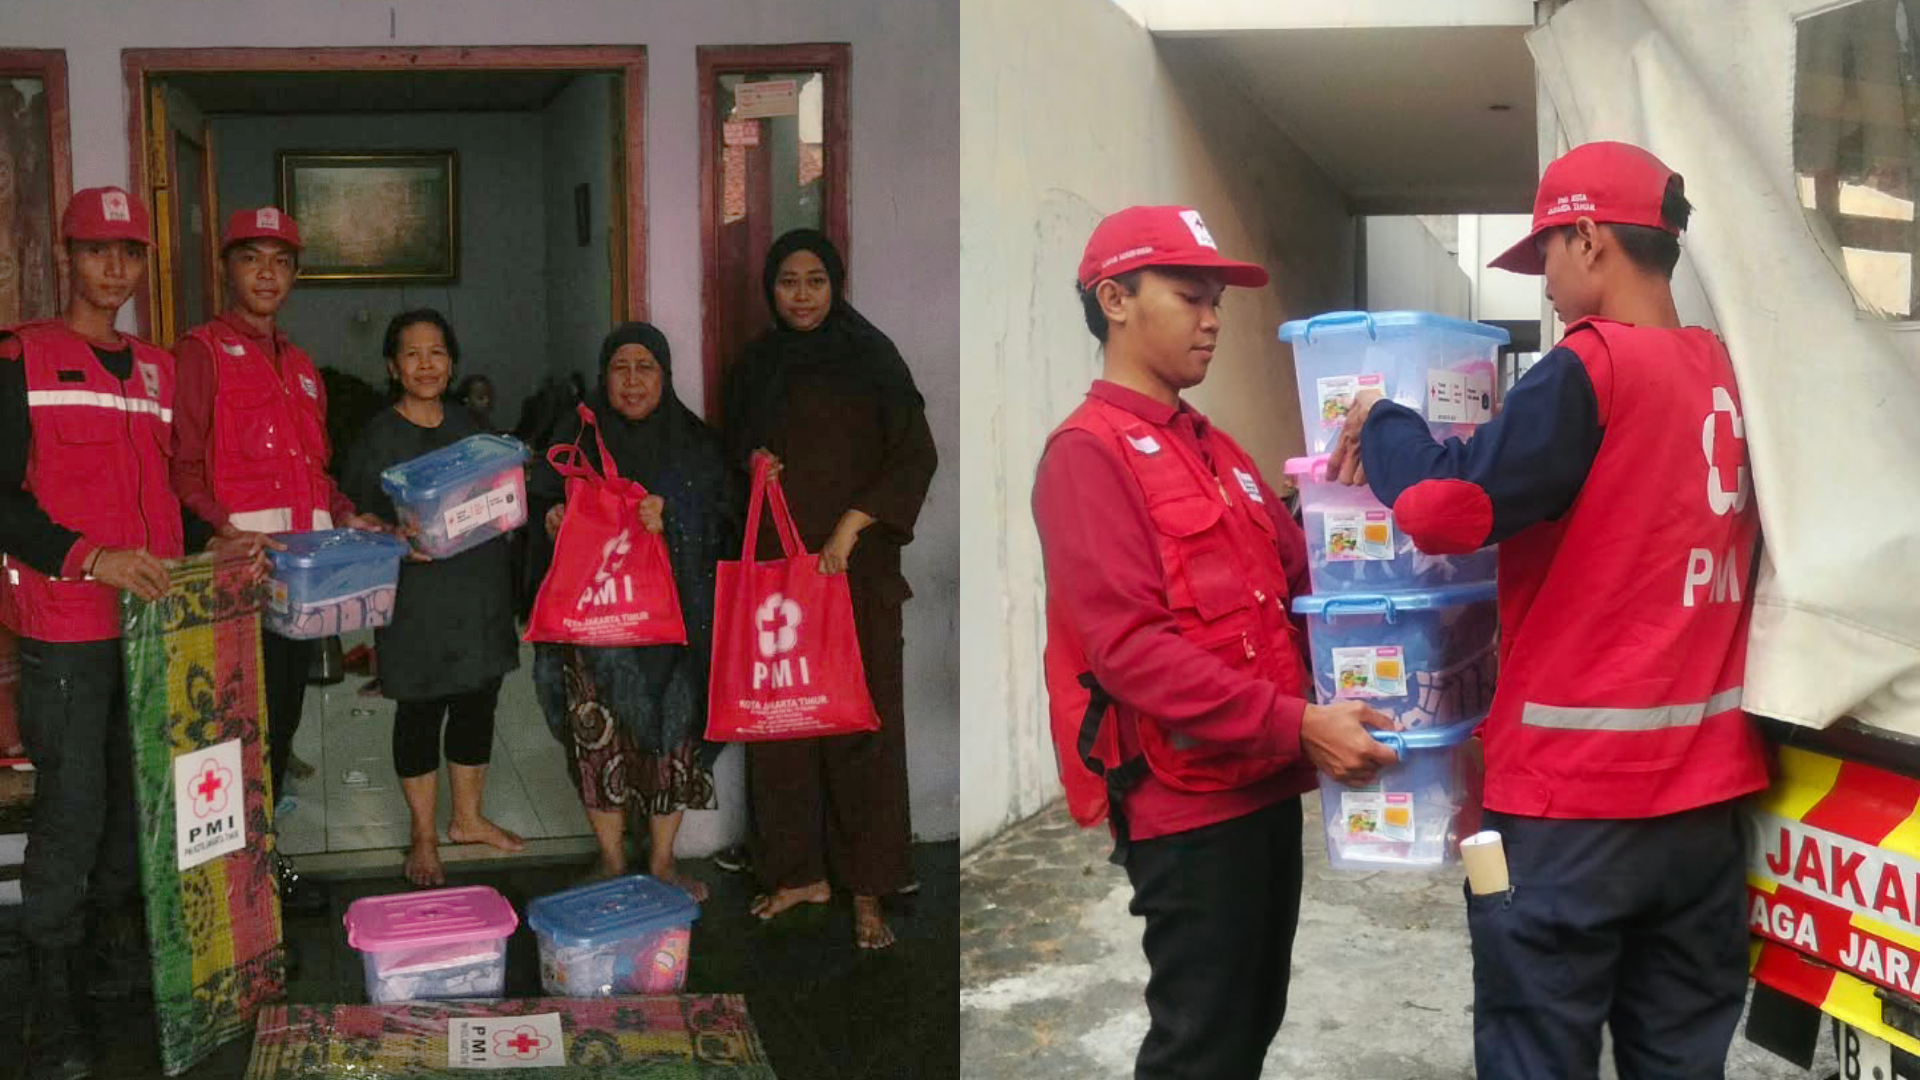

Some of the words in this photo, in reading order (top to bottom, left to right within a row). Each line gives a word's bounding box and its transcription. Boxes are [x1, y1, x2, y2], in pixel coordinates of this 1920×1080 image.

[577, 575, 634, 610] PMI
[1683, 546, 1741, 607] PM
[753, 656, 809, 690] PMI
[798, 695, 827, 706] TIMUR
[189, 815, 234, 843] PMI
[1766, 828, 1920, 927] JAKA
[1750, 894, 1818, 952] AGA
[472, 1026, 486, 1062] PMI
